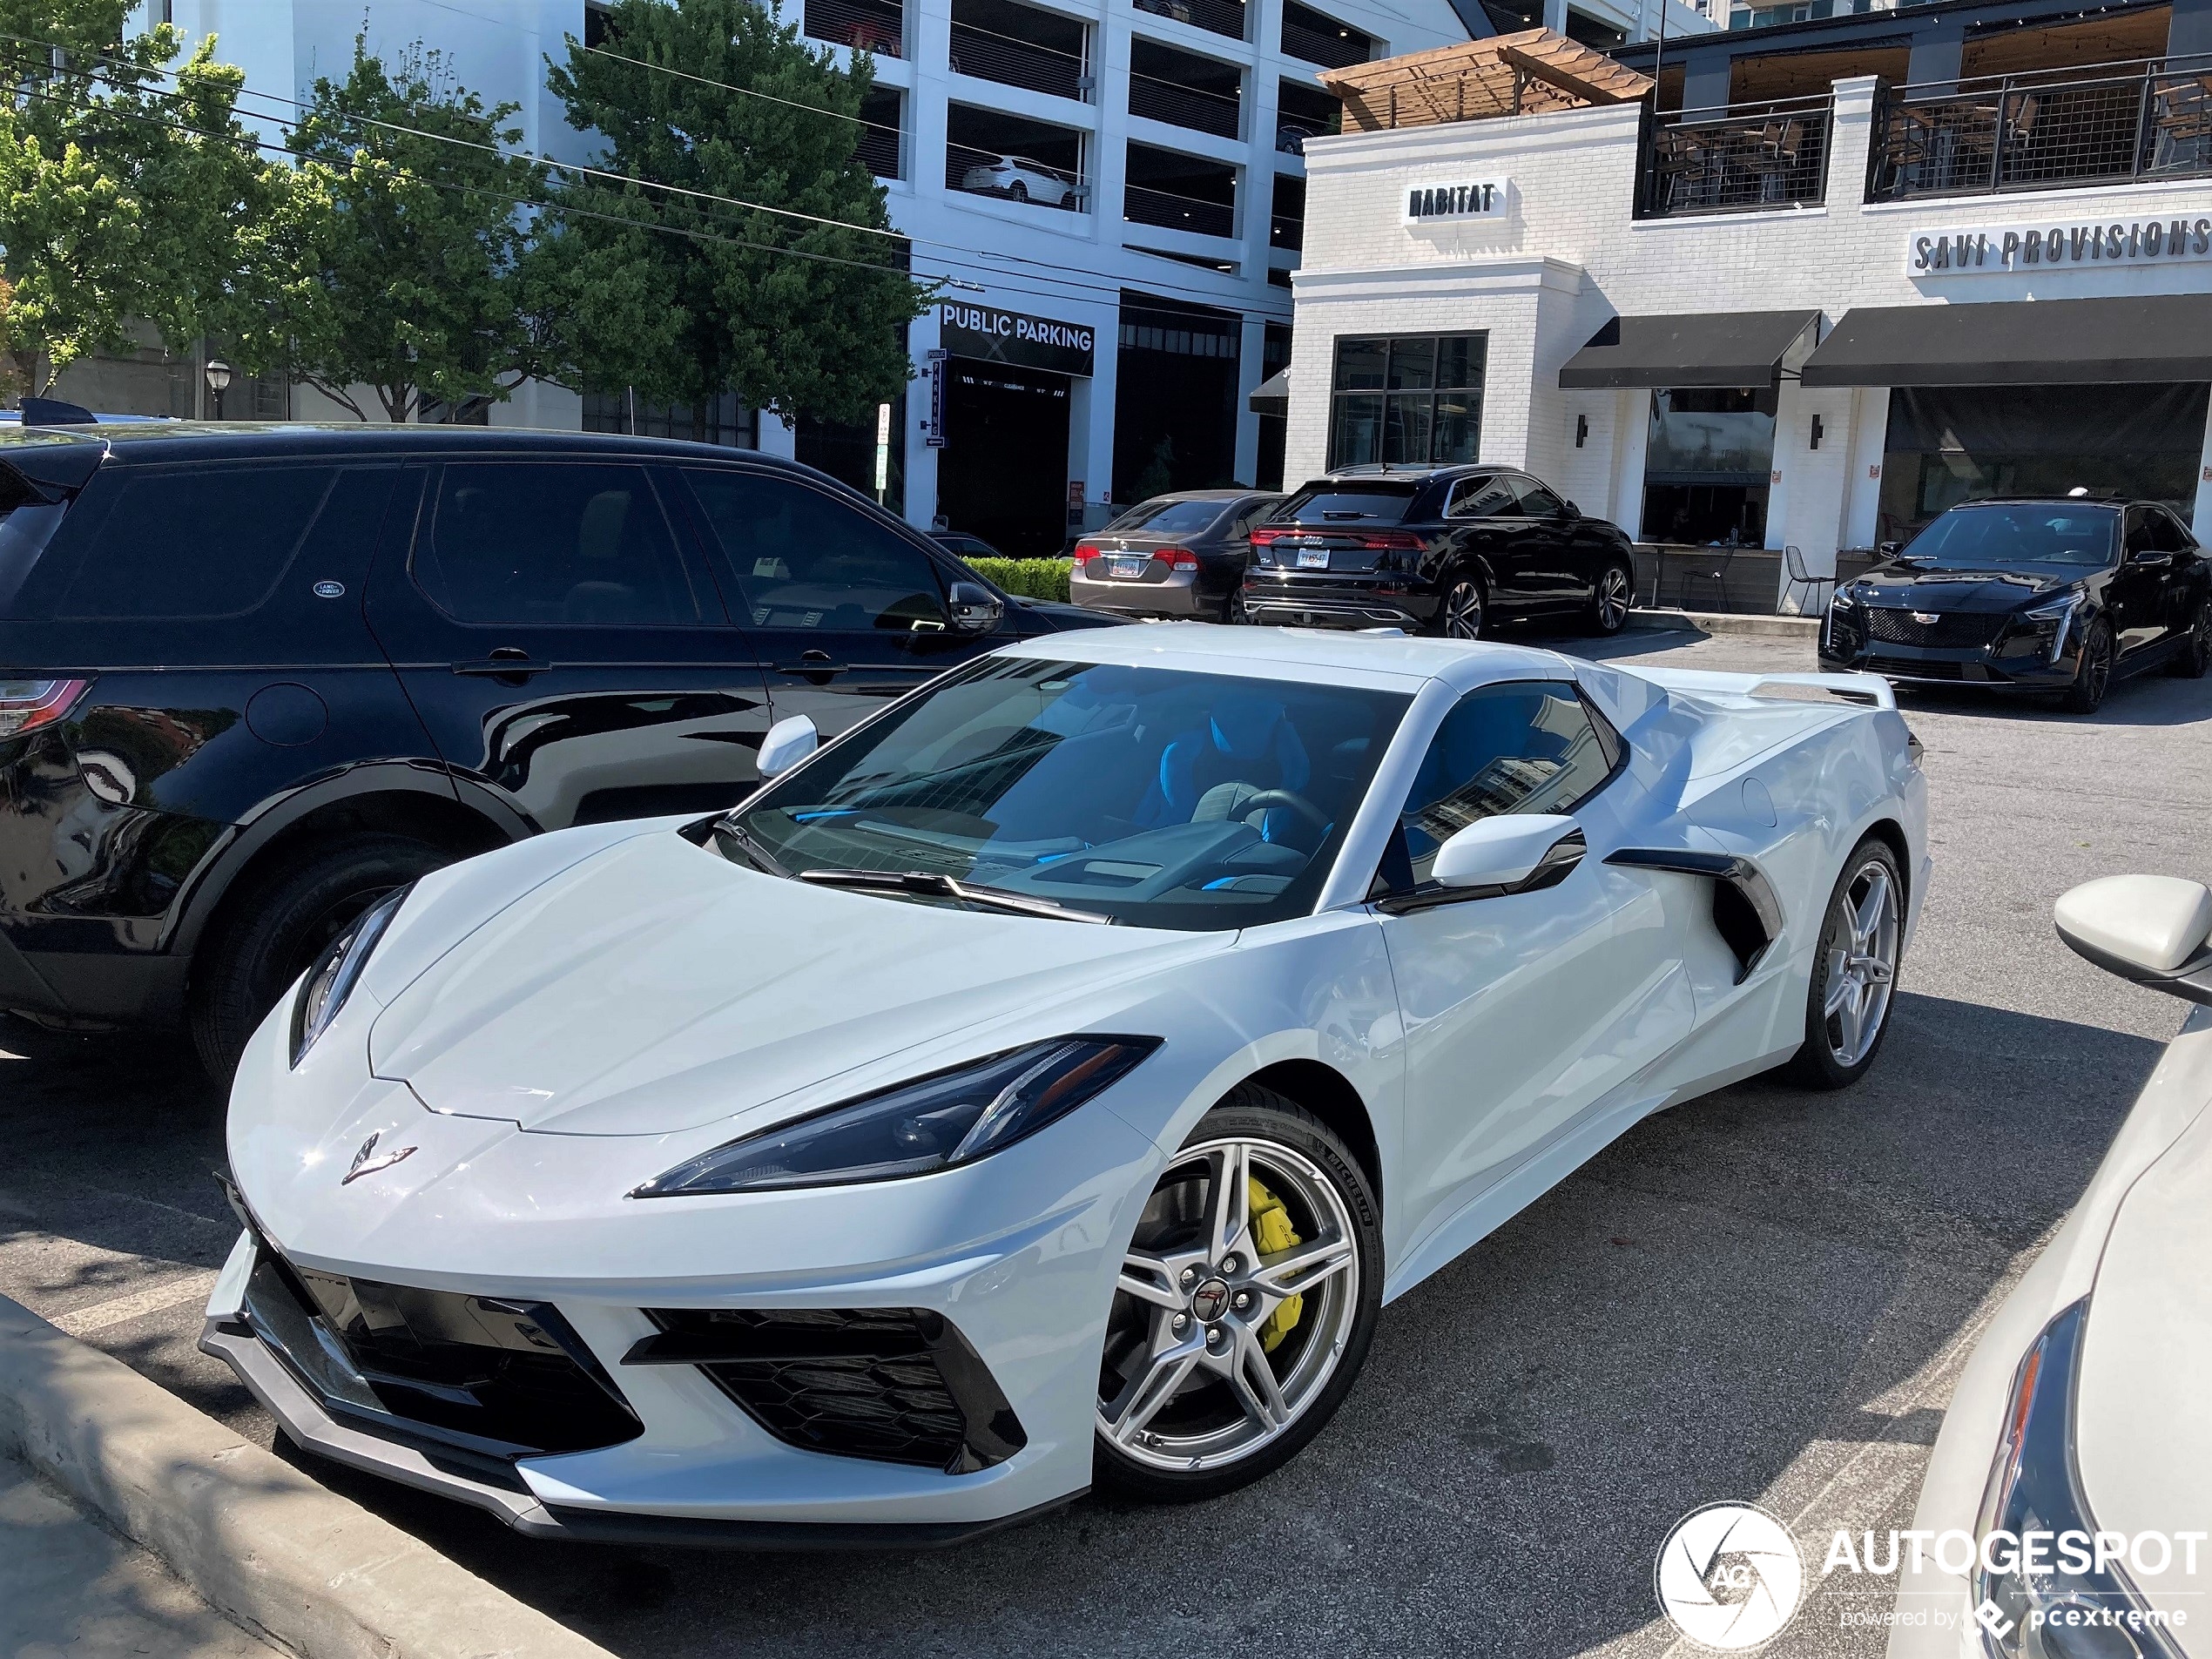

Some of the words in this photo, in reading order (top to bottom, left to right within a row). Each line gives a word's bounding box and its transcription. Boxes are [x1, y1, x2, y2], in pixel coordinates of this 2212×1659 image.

[1409, 184, 1495, 217] HABITAT
[1914, 233, 1986, 270] SAVI
[2001, 218, 2211, 265] PROVISIONS
[943, 305, 1012, 337] PUBLIC
[1016, 319, 1092, 352] PARKING
[1326, 1153, 1372, 1223] MICHELIN
